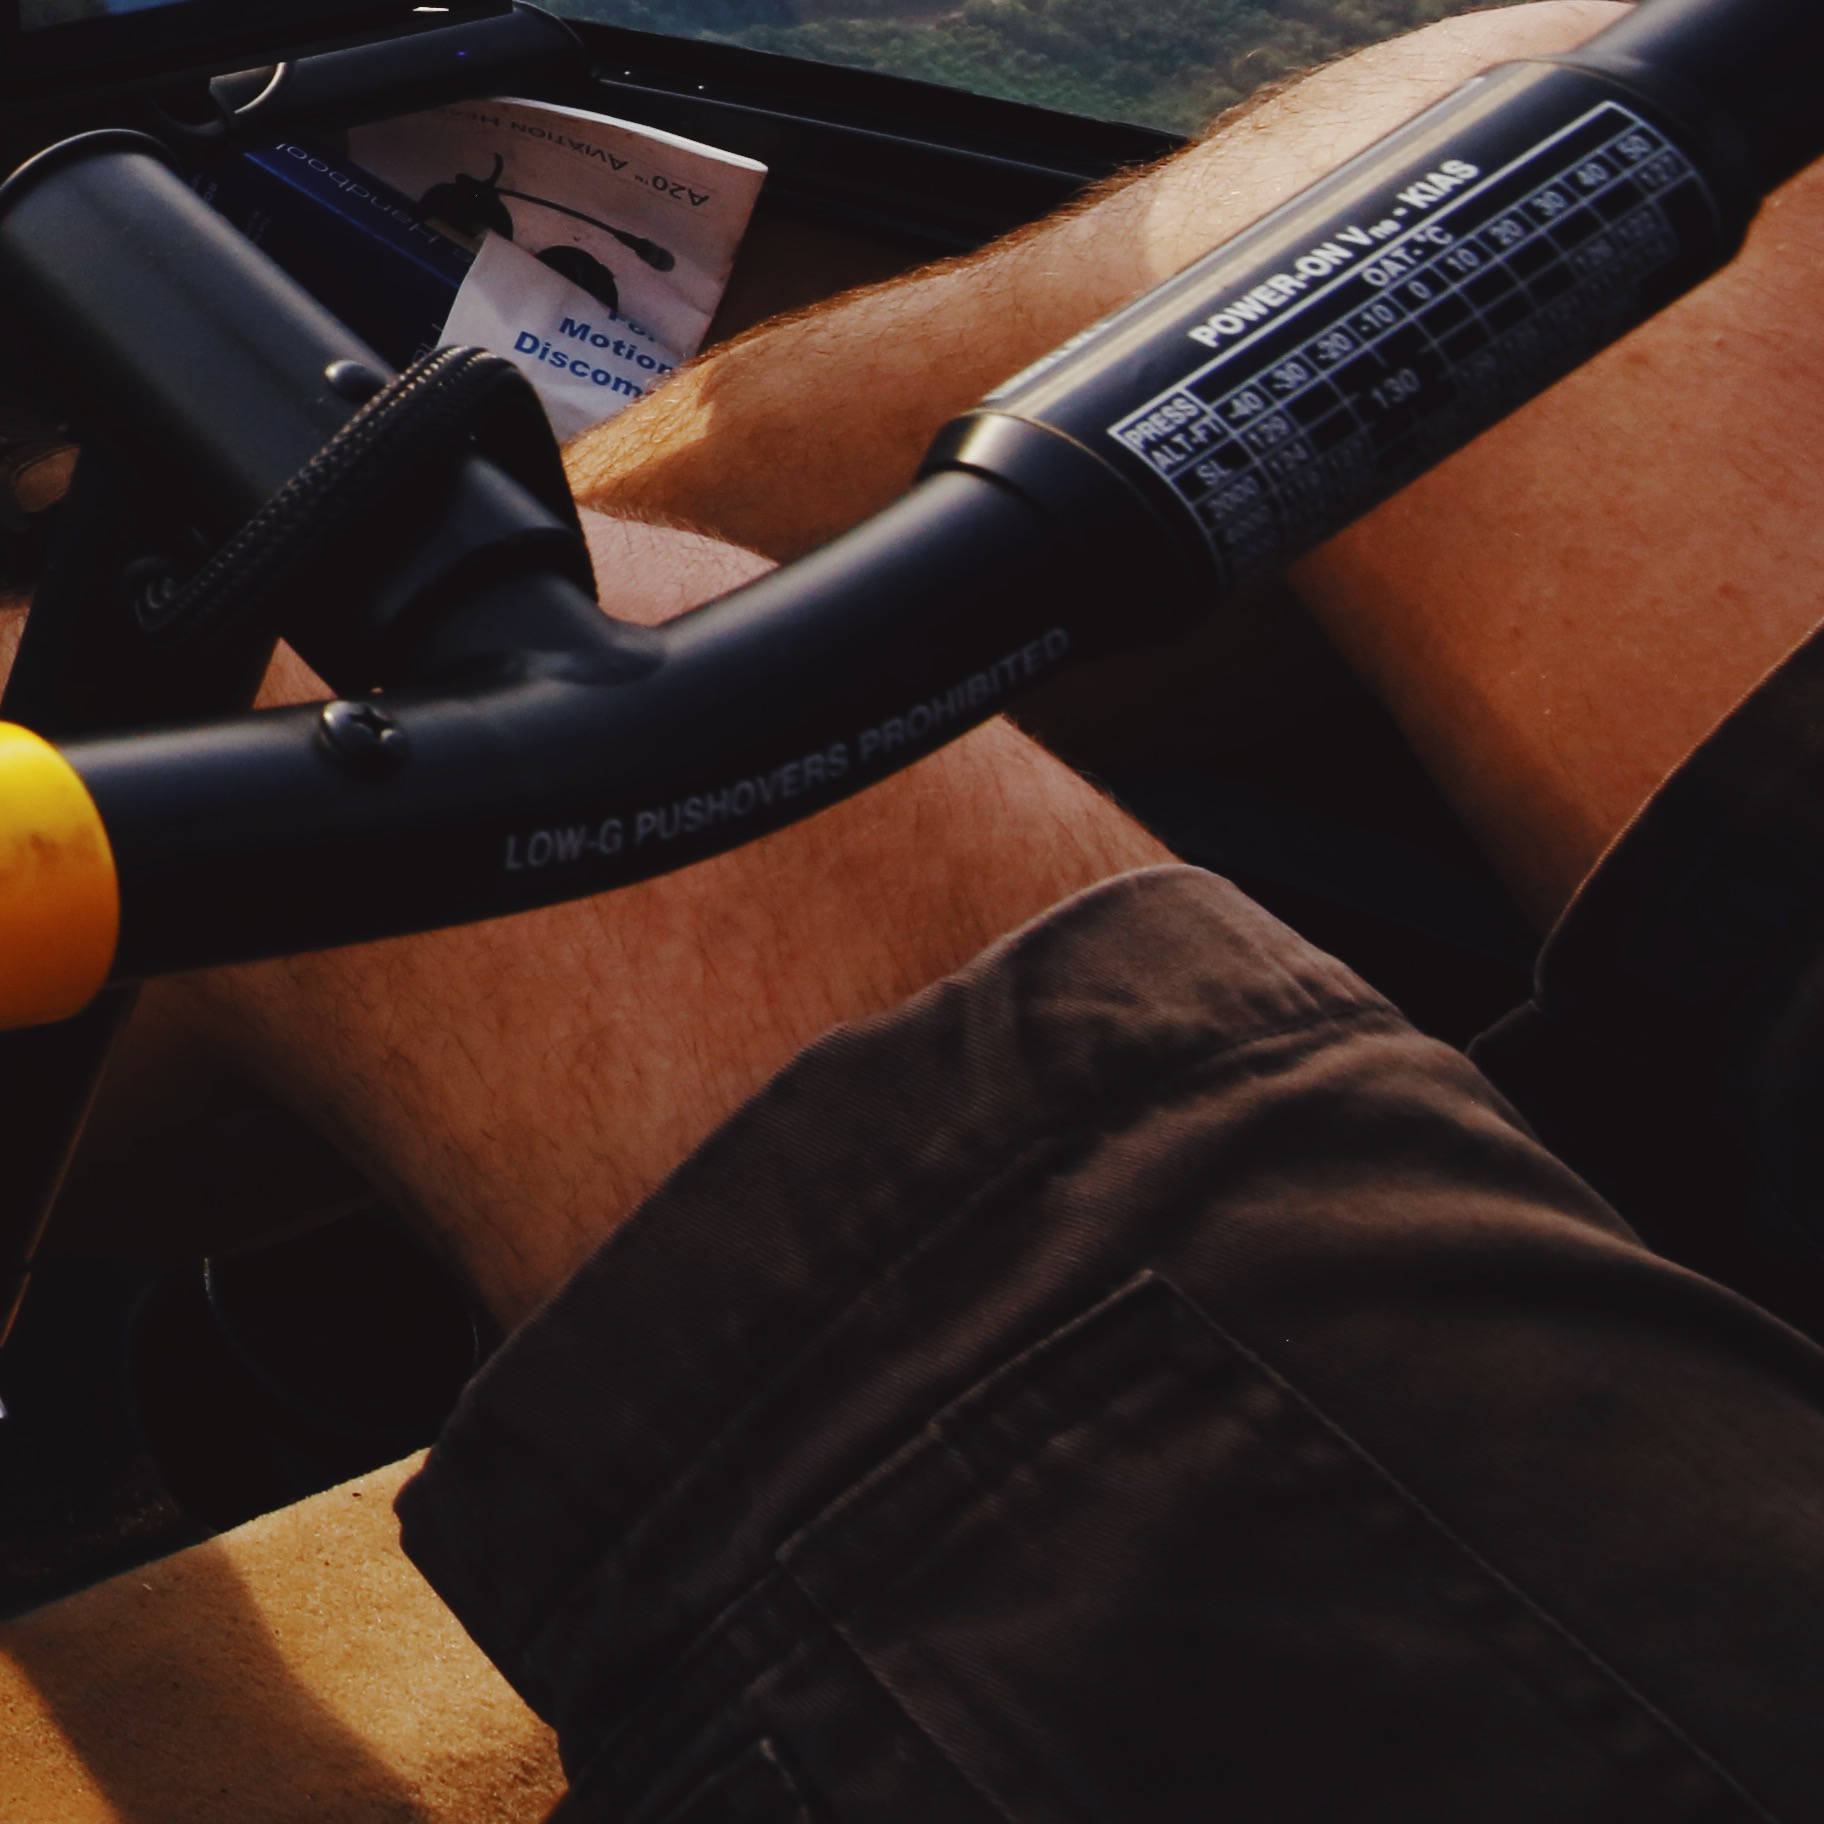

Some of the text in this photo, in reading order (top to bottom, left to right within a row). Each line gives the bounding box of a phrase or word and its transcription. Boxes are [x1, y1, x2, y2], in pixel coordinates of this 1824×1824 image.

[510, 120, 629, 172] AVIATION
[1187, 241, 1355, 349] POWER-ON
[1395, 159, 1482, 211] KIAS
[1446, 248, 1481, 273] 10
[1370, 367, 1422, 411] 130
[1123, 397, 1201, 450] PRESS
[502, 625, 1073, 872] LOW-G PUSHOVERS PROHIBITED
